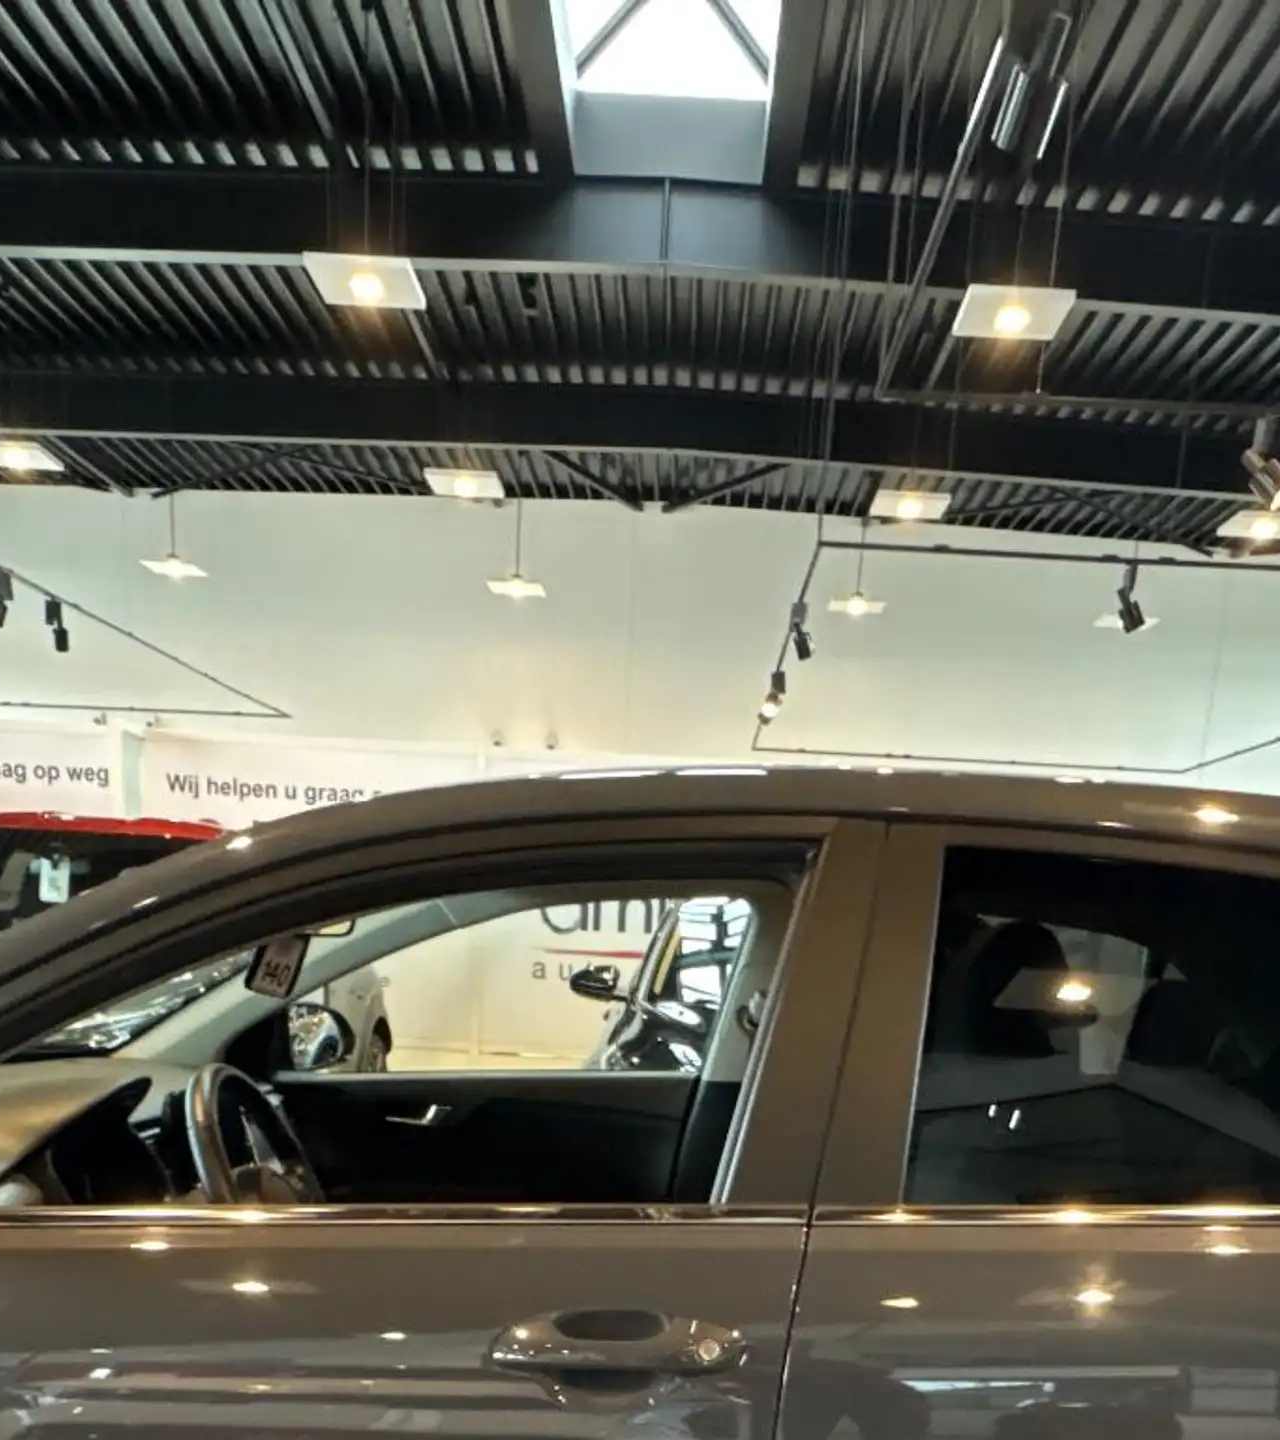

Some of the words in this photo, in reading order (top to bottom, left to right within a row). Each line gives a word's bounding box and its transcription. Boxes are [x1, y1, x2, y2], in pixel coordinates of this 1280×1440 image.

[33, 763, 61, 785] op
[66, 767, 109, 787] weg
[166, 773, 200, 799] Wij
[206, 777, 277, 801] helpen
[284, 785, 297, 800] u
